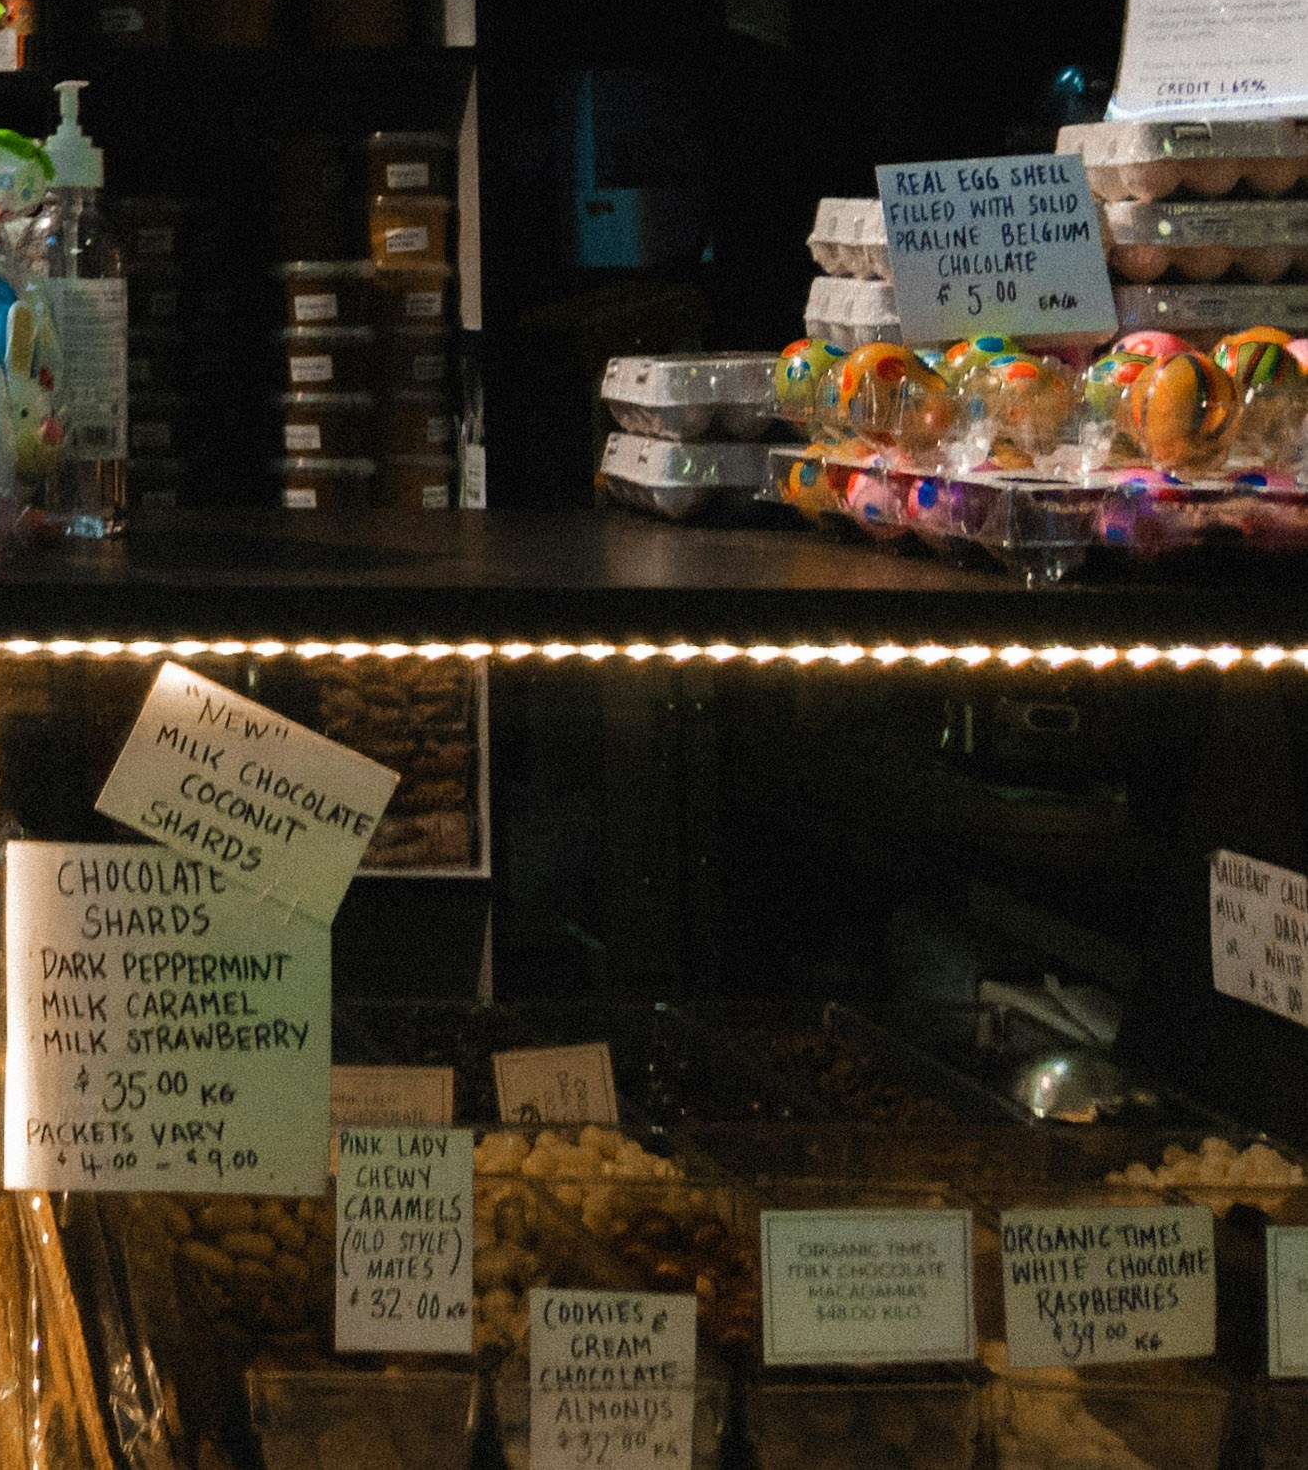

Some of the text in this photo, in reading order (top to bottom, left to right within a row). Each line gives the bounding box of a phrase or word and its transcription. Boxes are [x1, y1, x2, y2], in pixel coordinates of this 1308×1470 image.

[1156, 81, 1210, 98] CREDIT
[896, 164, 1070, 196] REAL EGG SHELL
[890, 193, 1079, 225] FILLED WITH SOLID
[895, 221, 1091, 252] PRALINE BELGIUM
[937, 251, 1038, 278] CHOCOLATE
[156, 724, 376, 838] MILK CHOCOLATE
[179, 773, 308, 844] COCONUT
[140, 800, 264, 872] SHARDS
[56, 859, 228, 897] CHOCOLATE
[81, 903, 212, 941] SHARDS
[41, 947, 292, 987] DARK PEPPERMINT
[42, 988, 260, 1023] MILK CARAMEL
[42, 1021, 309, 1055] MILK STRAWBERRY
[200, 1083, 238, 1107] KG
[26, 1119, 226, 1148] PACKETS VARY
[339, 1131, 449, 1159] PINK LADY
[355, 1164, 434, 1191] CHEWY
[343, 1193, 463, 1224] CARAMELS
[1001, 1221, 1182, 1257] ORGANIC TIMES
[367, 1257, 436, 1281] MATES
[1010, 1246, 1212, 1287] WHITE CHOCOLATE
[543, 1298, 644, 1331] COOKIES
[1035, 1283, 1180, 1323] RASPBERRIES
[570, 1332, 652, 1361] CREAM
[539, 1361, 678, 1393] CHOCOLATE
[555, 1397, 674, 1426] ALMONDS
